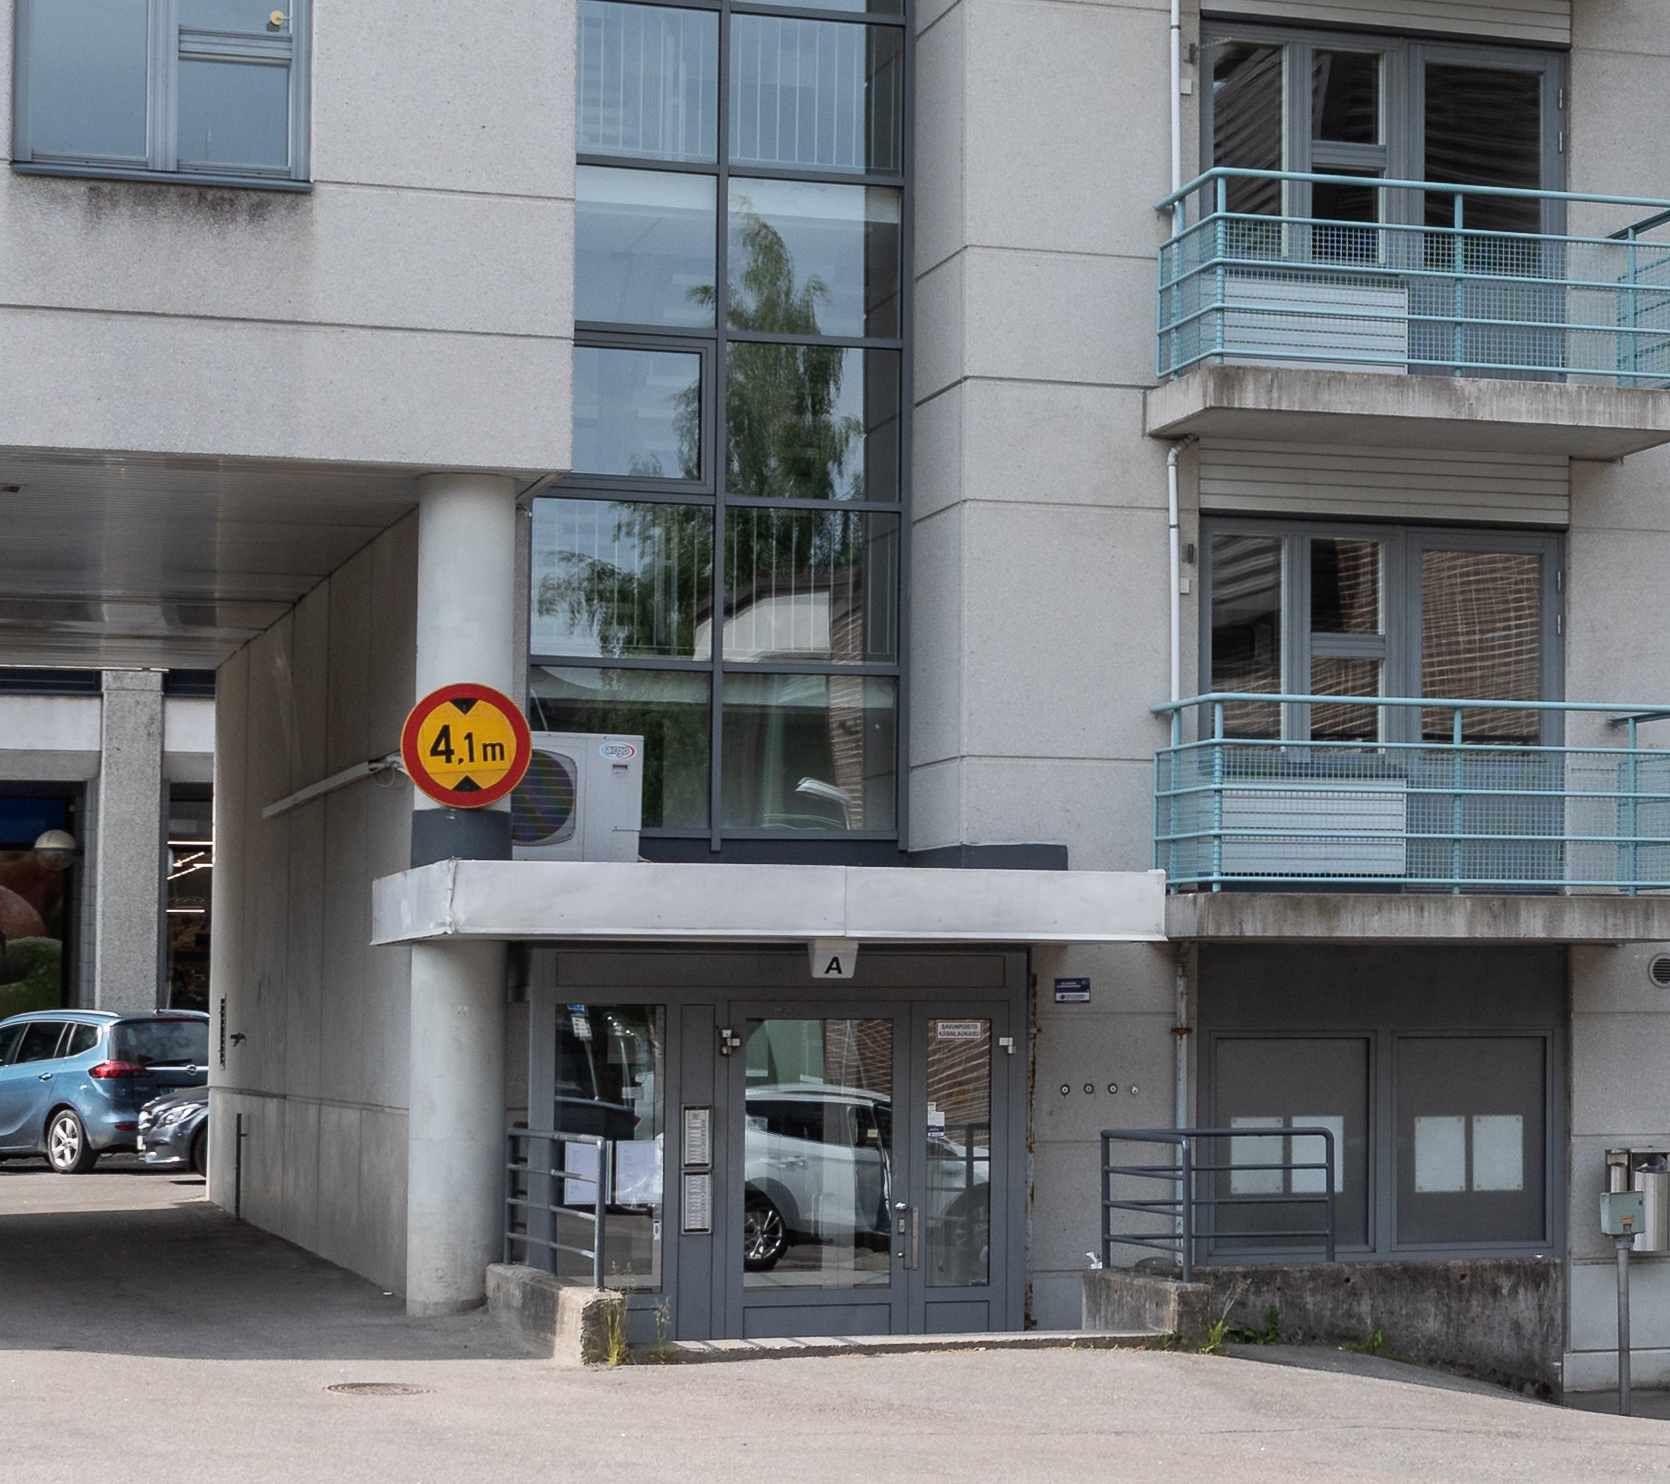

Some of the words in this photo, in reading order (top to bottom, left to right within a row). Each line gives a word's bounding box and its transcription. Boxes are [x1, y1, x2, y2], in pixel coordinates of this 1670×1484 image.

[482, 741, 505, 762] m
[605, 746, 630, 758] argo
[824, 955, 843, 975] A
